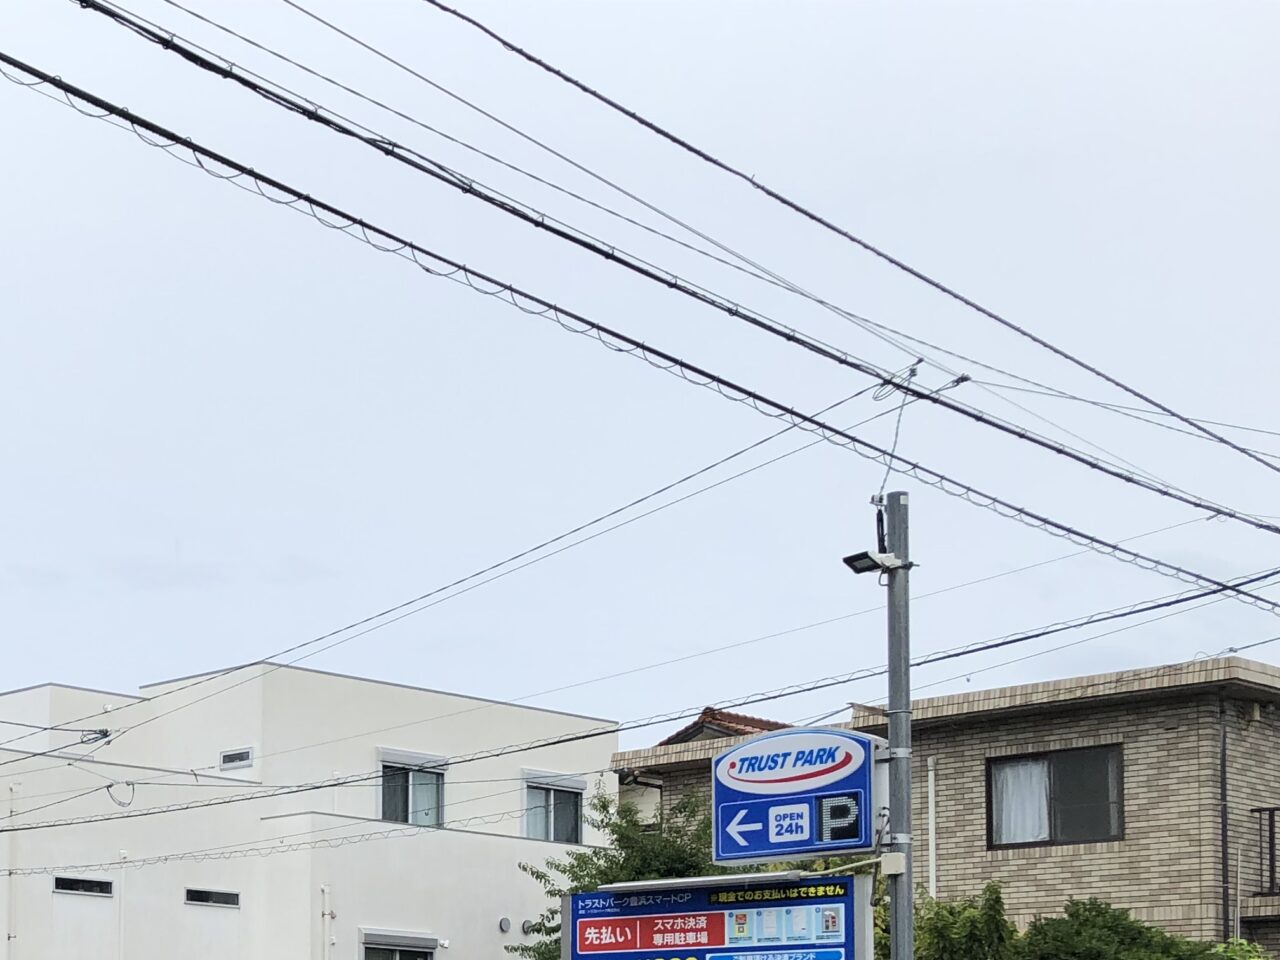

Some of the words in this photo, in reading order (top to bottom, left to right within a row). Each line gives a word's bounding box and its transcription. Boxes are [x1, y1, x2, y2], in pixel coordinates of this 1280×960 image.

[738, 751, 791, 774] TRUST
[792, 746, 840, 768] PARK
[774, 811, 804, 822] OPEN
[822, 796, 859, 842] P
[774, 824, 804, 836] 24h
[653, 916, 707, 931] スマホ決済
[584, 926, 632, 945] 先払い
[652, 931, 708, 946] 専用駐車場
